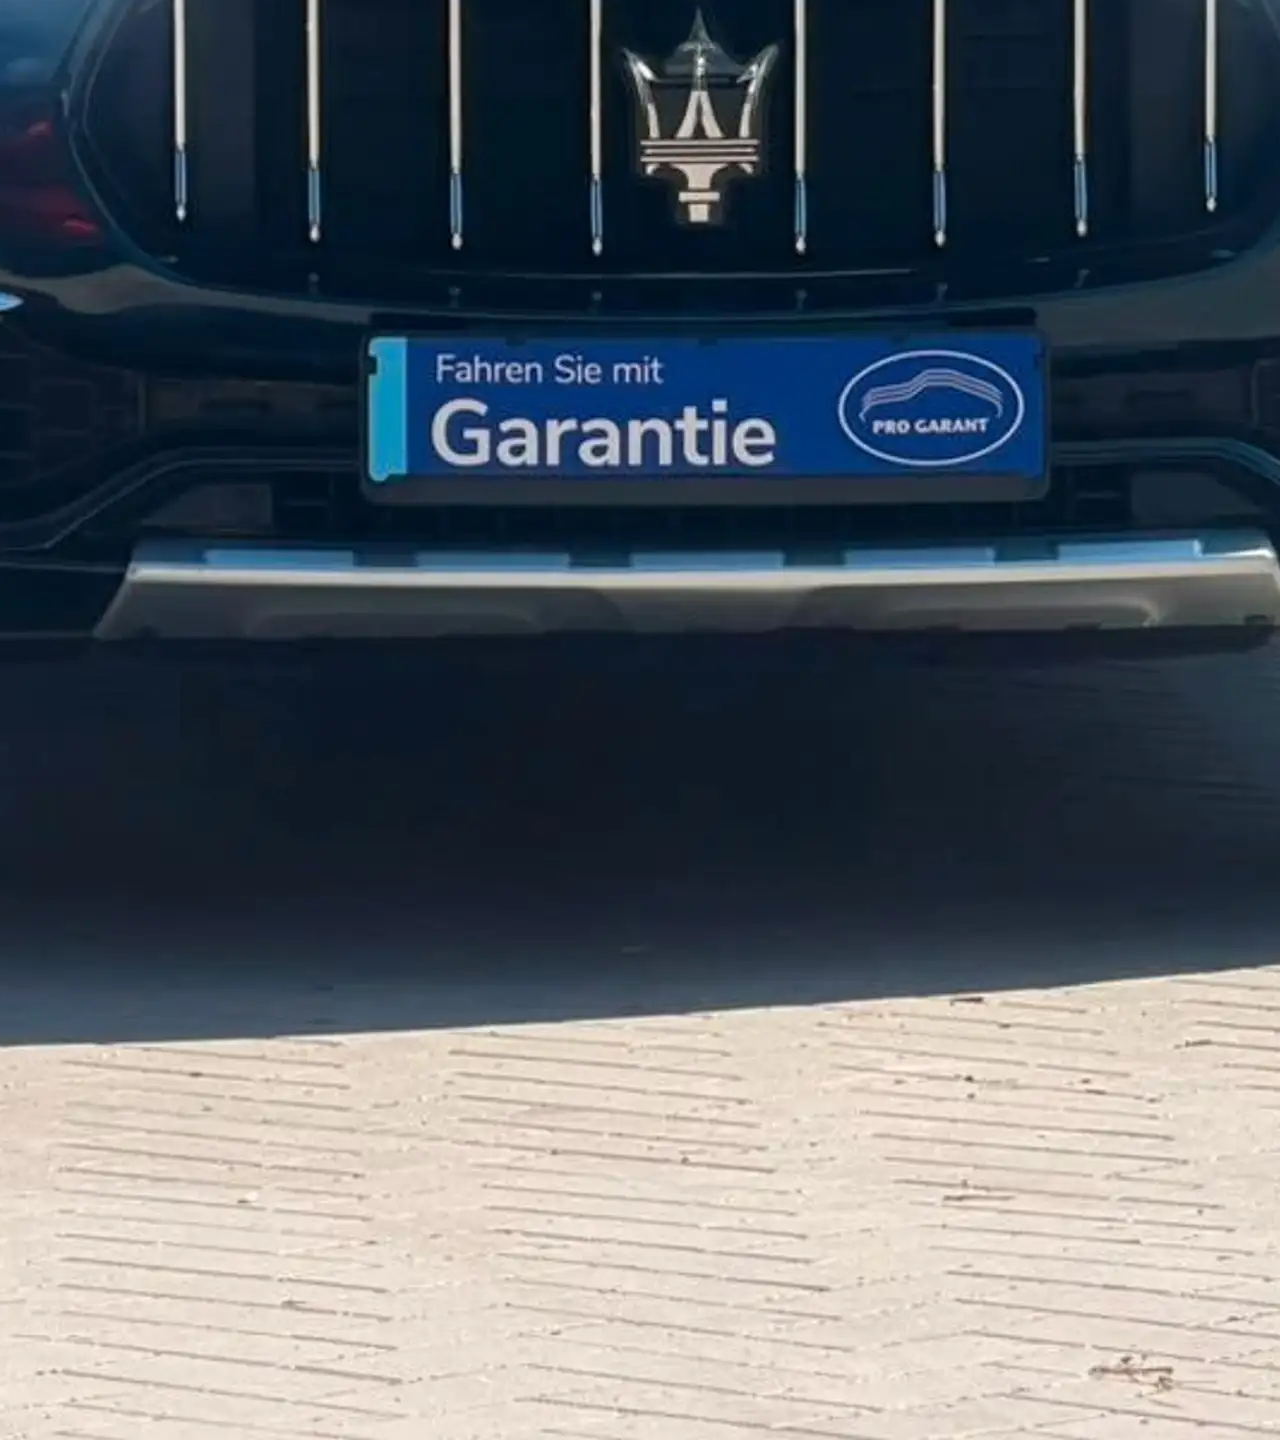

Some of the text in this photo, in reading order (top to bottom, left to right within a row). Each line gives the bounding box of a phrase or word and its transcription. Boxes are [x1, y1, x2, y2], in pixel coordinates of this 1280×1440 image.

[436, 353, 665, 385] Fahren Sie mit
[431, 397, 776, 466] Garantie
[872, 417, 990, 435] PRO GARANT
